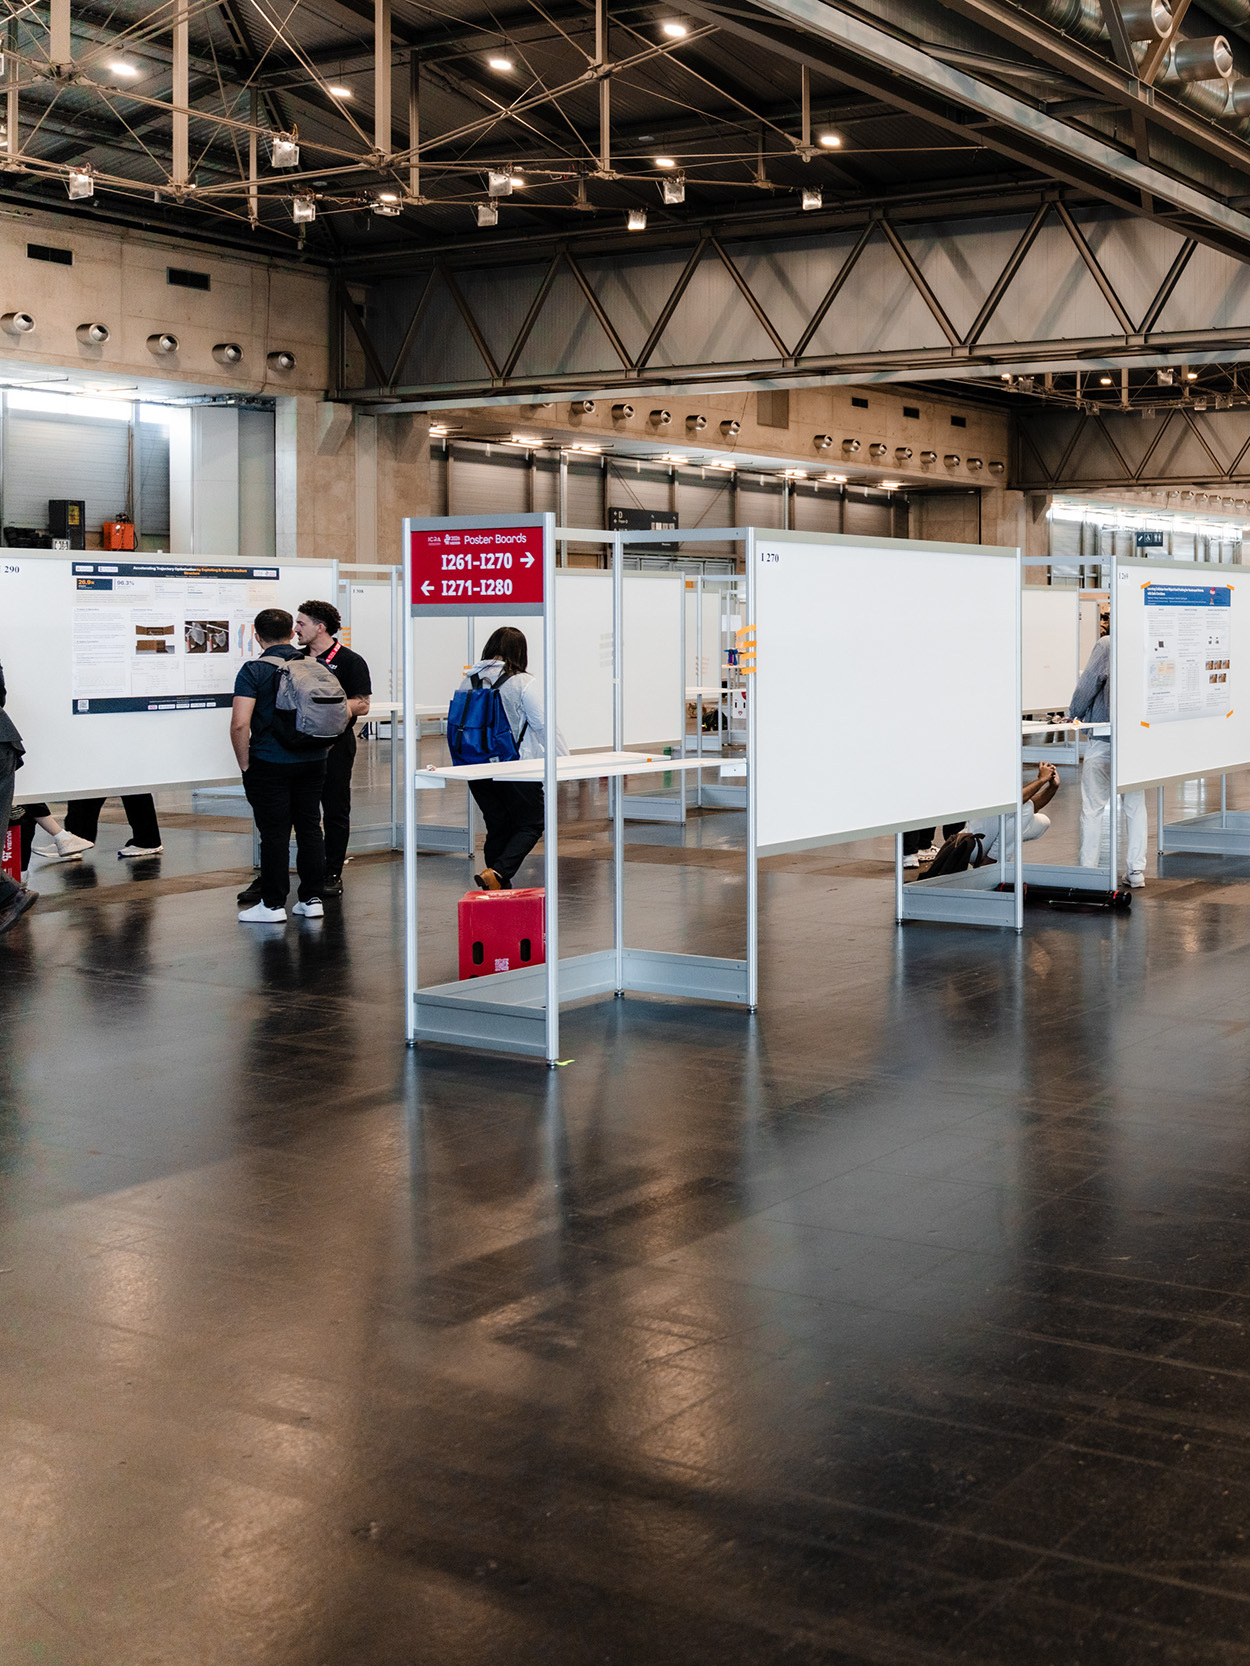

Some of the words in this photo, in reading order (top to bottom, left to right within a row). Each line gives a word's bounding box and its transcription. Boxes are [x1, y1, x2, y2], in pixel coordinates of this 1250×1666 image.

[464, 534, 494, 545] Poster
[495, 533, 527, 544] Boards
[441, 552, 513, 570] I261-I270
[761, 552, 764, 562] I
[766, 552, 780, 563] 270
[4, 565, 20, 573] 290
[441, 578, 513, 596] I271-I280
